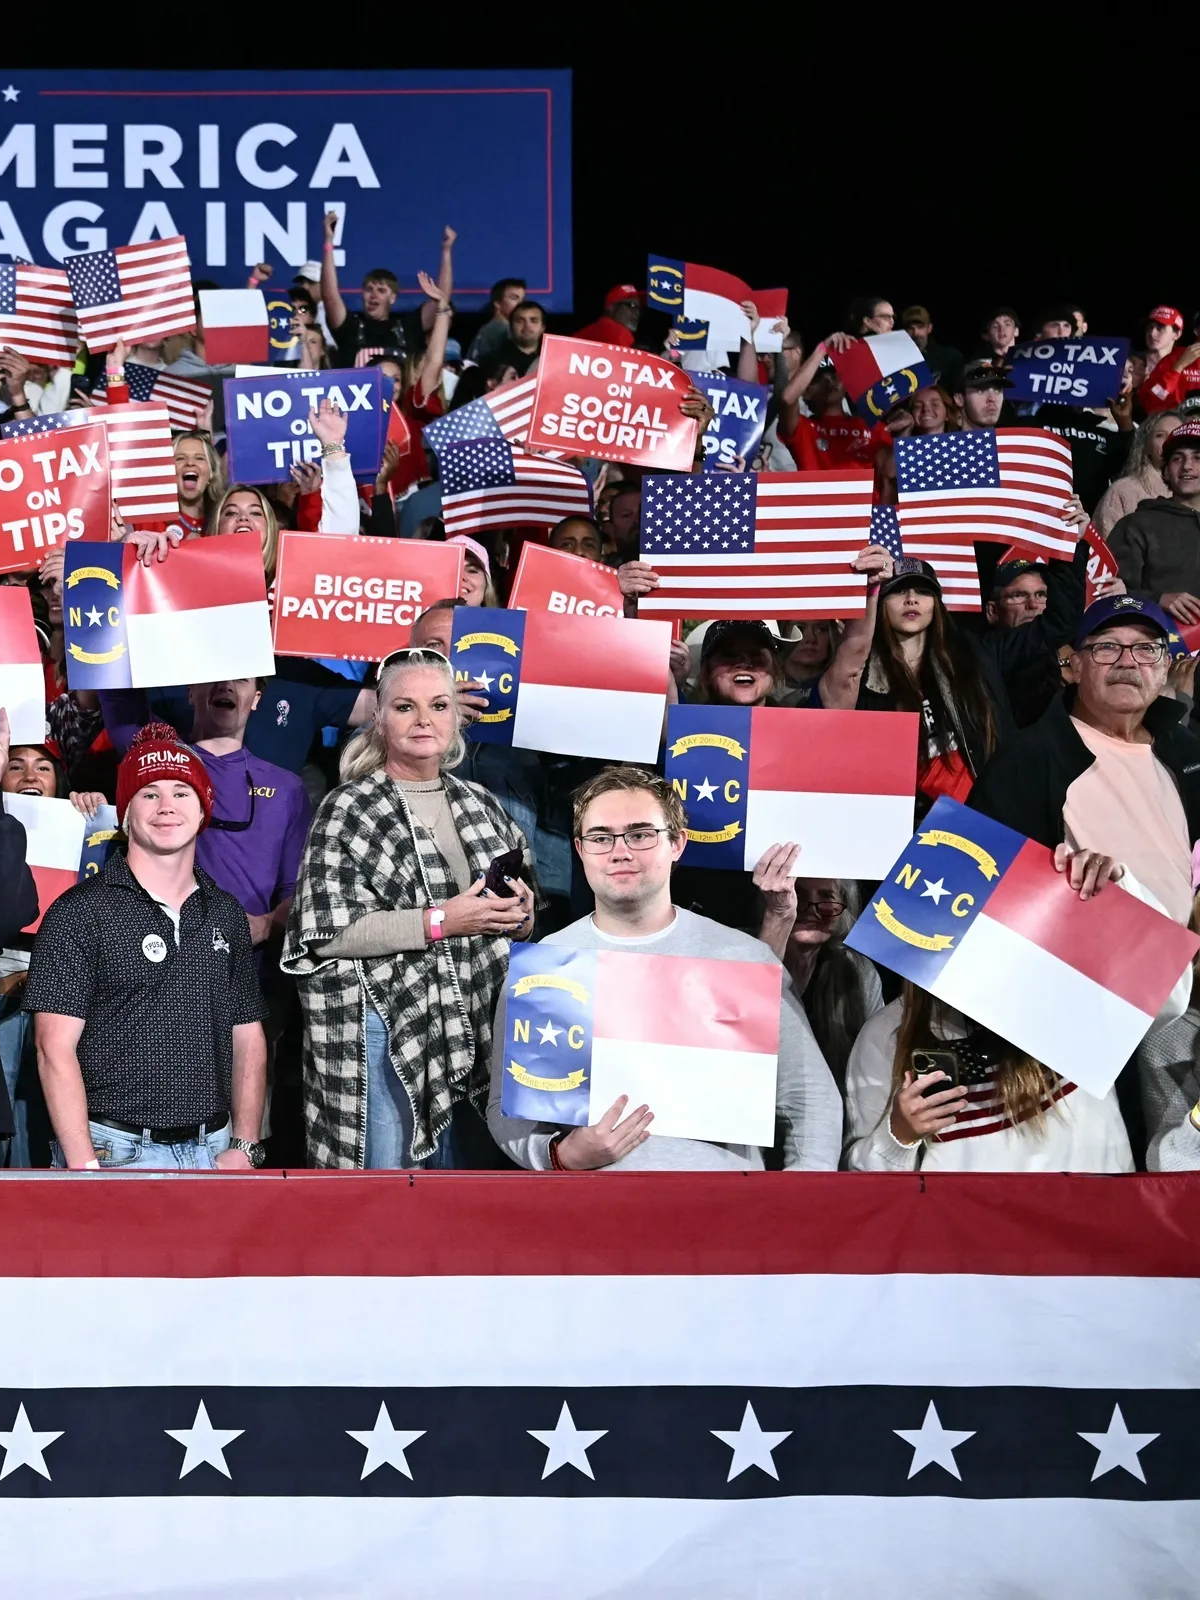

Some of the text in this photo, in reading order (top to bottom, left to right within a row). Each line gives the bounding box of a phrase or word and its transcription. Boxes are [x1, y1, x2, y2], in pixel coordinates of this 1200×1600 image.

[820, 356, 834, 368] SA
[1014, 344, 1120, 366] NO TAX
[1050, 361, 1074, 374] ON
[568, 352, 675, 390] NO TAX
[606, 383, 632, 399] ON
[1029, 374, 1088, 398] TIPS
[236, 383, 374, 420] NO TAX
[561, 393, 668, 431] SOCIAL
[708, 388, 760, 422] TAX
[540, 414, 687, 455] SECURITY
[707, 418, 721, 432] N
[267, 440, 323, 468] TIP
[705, 435, 736, 464] PS
[32, 442, 103, 484] TAX
[26, 486, 62, 510] ON
[2, 508, 85, 552] TIPS
[314, 574, 423, 602] BIGGER
[70, 606, 120, 626] N C
[282, 596, 430, 626] PAYCHEC
[548, 590, 624, 618] BIGG
[464, 636, 478, 644] MAY
[498, 673, 513, 694] C
[680, 738, 697, 748] MAY
[718, 738, 736, 750] 1775
[138, 750, 190, 766] TRUMP
[672, 778, 740, 802] N C
[715, 830, 732, 841] 1776
[933, 832, 953, 843] MAY
[975, 848, 992, 867] 1775
[894, 862, 975, 918] N C
[879, 911, 900, 932] APRIL
[920, 938, 939, 950] 1776
[145, 941, 164, 951] TPUSA
[514, 1018, 585, 1049] N C
[516, 1072, 540, 1088] APRIL
[558, 1078, 577, 1090] 1776
